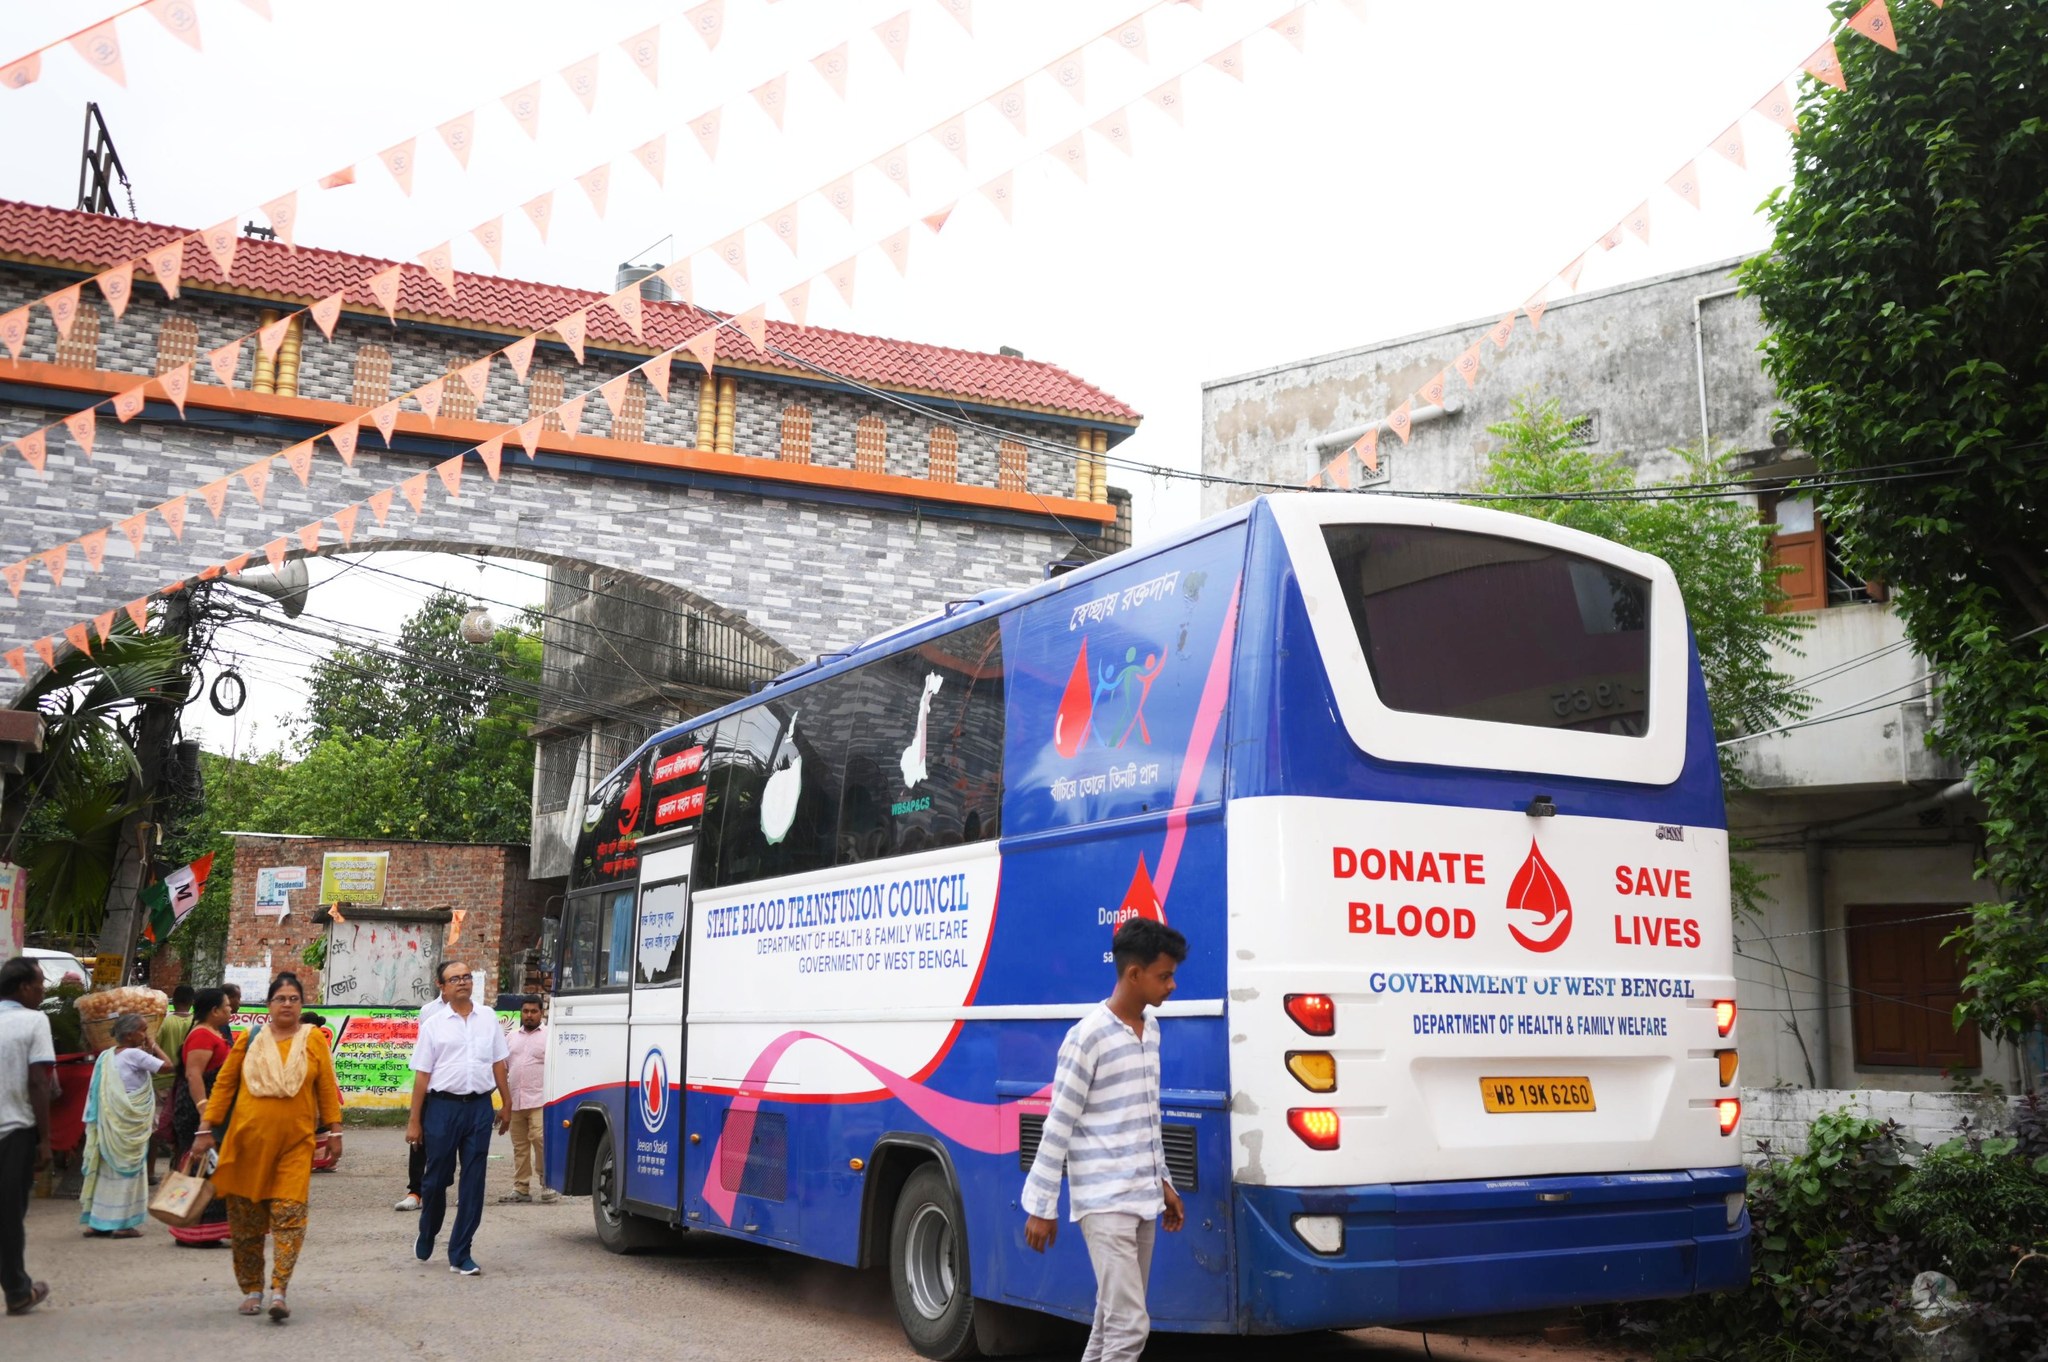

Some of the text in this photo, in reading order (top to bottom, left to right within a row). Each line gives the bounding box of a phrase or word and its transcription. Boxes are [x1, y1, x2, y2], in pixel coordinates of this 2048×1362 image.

[1069, 570, 1180, 632] স্বেচ্ছায় রক্তদান
[1080, 774, 1106, 798] তোলে
[1109, 762, 1137, 792] তিনটি
[1333, 847, 1485, 884] DONATE
[1615, 865, 1692, 899] SAVE
[274, 881, 304, 889] Residential
[707, 873, 969, 938] STATE BLOOD TRANSFUSION COUNCIL
[1098, 906, 1139, 925] Donate
[1348, 902, 1476, 939] BLOOD
[757, 920, 968, 955] DEPARTMENT OF HEALTH & FAMILY WELFARE
[1614, 914, 1701, 948] LIVES
[799, 949, 968, 973] GOVERNMENT OF WEST BENGAL
[330, 976, 357, 996] ভোট
[1369, 973, 1694, 999] GOVERNMENT OF WEST BENGAL
[1413, 1014, 1667, 1037] DEPARTMENT OF HEALTH & FAMILY WELFARE
[1494, 1084, 1589, 1105] WB 19K 6260
